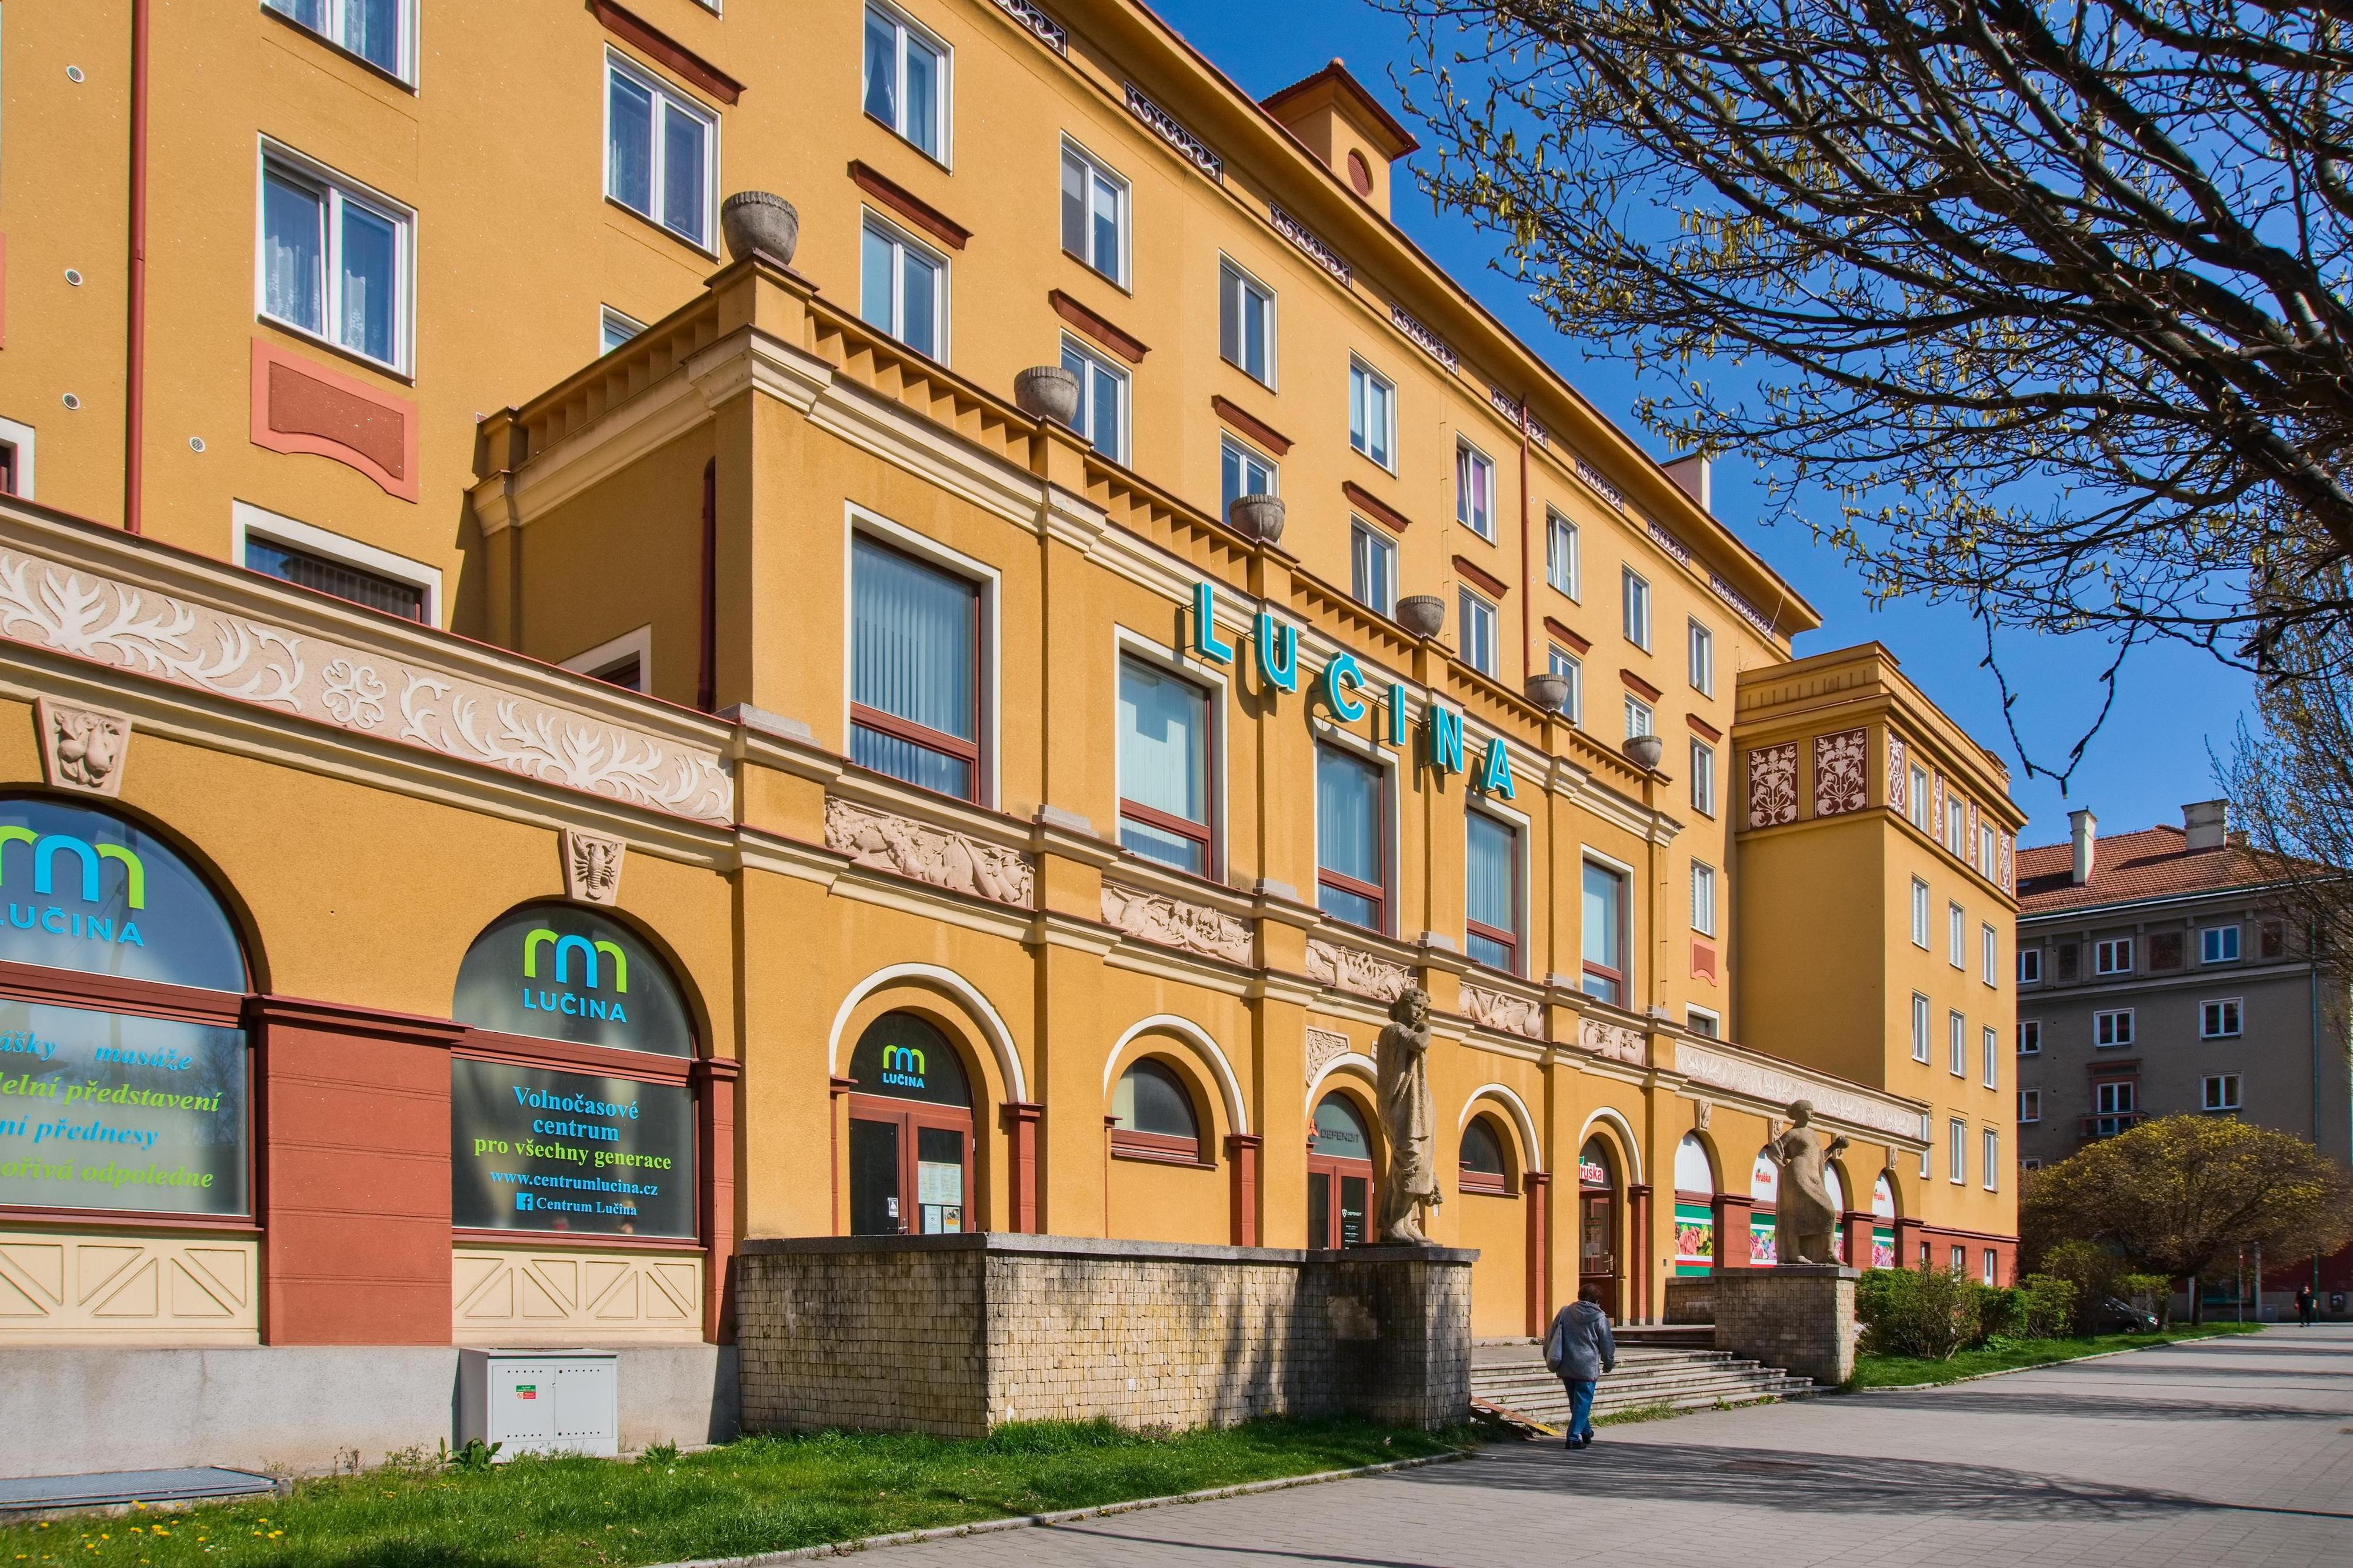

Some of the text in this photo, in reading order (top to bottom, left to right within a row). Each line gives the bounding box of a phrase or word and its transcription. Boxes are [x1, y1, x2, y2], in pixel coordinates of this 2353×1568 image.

[1193, 581, 1515, 800] LUČINA
[0, 903, 144, 947] UČINA
[524, 988, 628, 1023] LUČINA
[94, 1045, 193, 1071] masáže
[883, 1072, 925, 1089] LUČINA
[62, 1079, 223, 1112] představení
[512, 1086, 639, 1119] Volnočasové
[32, 1117, 160, 1151] přednesy
[533, 1119, 620, 1142] centrum
[1320, 1129, 1359, 1143] DEFENDIT
[474, 1138, 672, 1170] pro všechny generace
[81, 1160, 214, 1189] odpoledne
[490, 1171, 659, 1196] www.centrumlucina.cz
[1579, 1164, 1602, 1181] ruška
[536, 1197, 593, 1213] Centrum
[595, 1201, 638, 1216] Lučina
